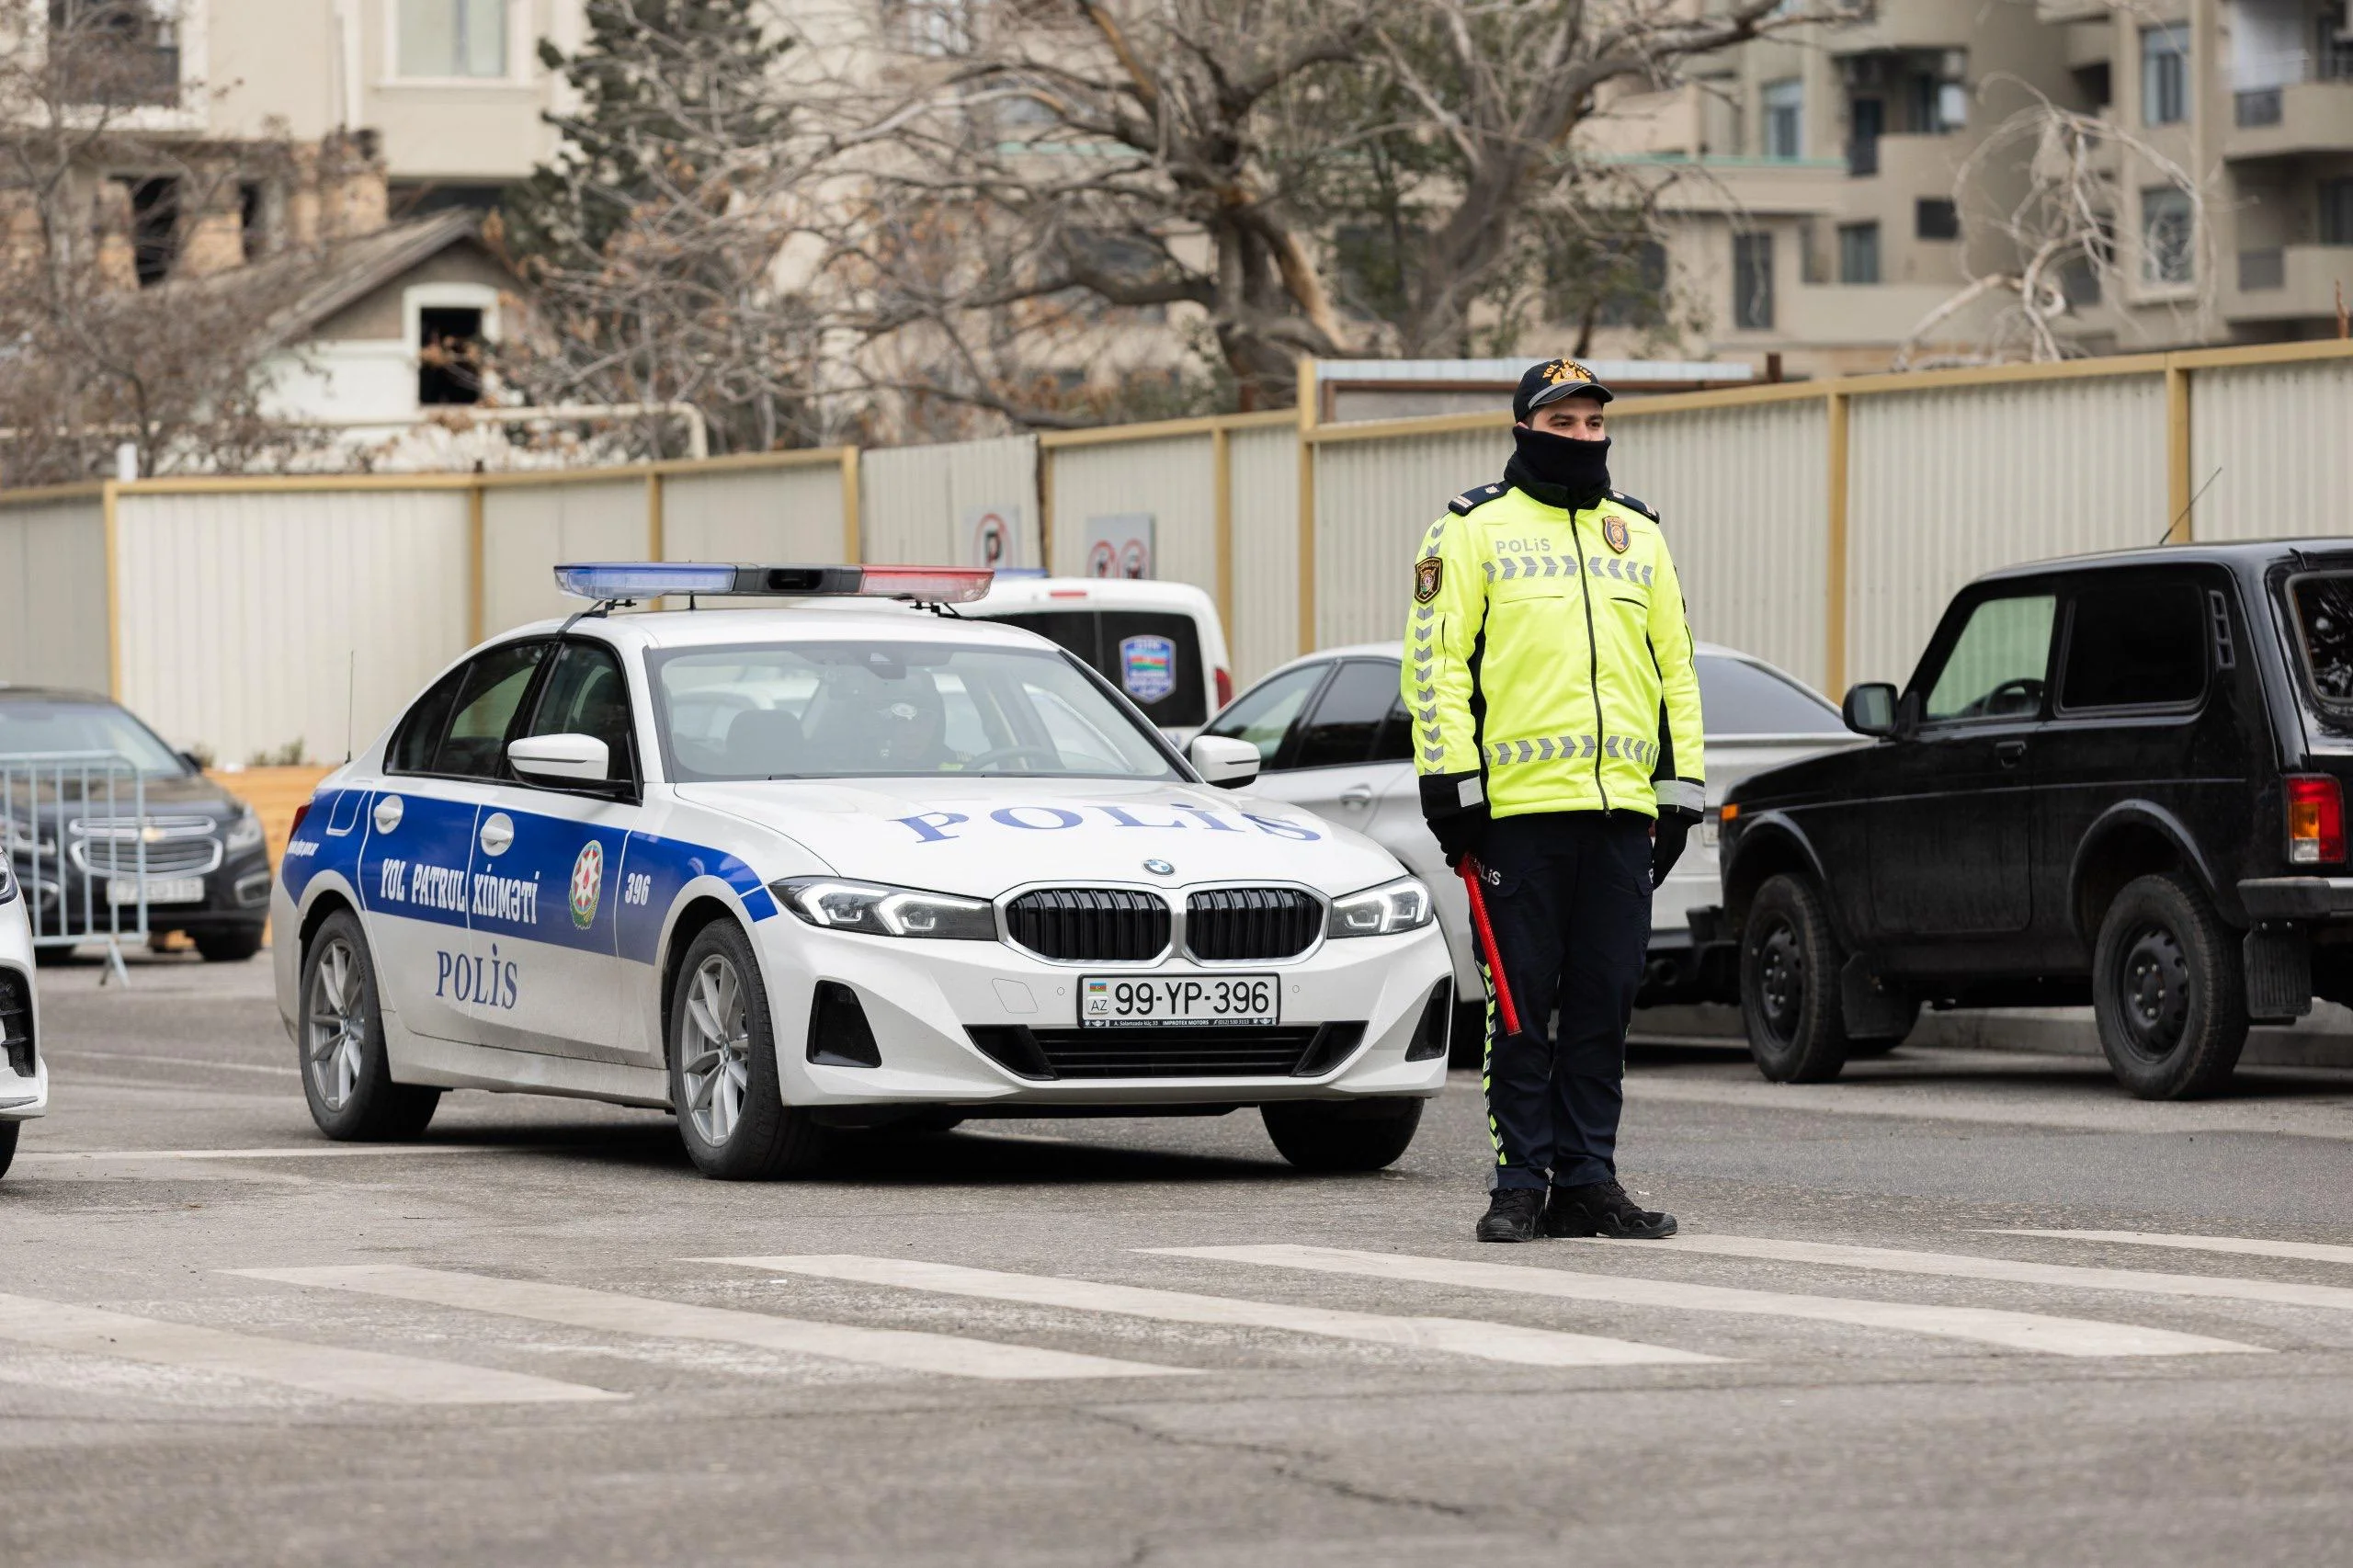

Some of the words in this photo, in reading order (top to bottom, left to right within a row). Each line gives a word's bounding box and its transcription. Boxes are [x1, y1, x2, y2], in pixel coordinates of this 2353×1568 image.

[381, 858, 406, 902] YOL
[411, 864, 466, 913] PATRUL
[1473, 858, 1501, 885] LiS
[625, 873, 651, 905] 396
[436, 943, 517, 1009] POLİS
[1091, 1000, 1108, 1012] AZ
[1115, 982, 1269, 1015] 99-YP-396
